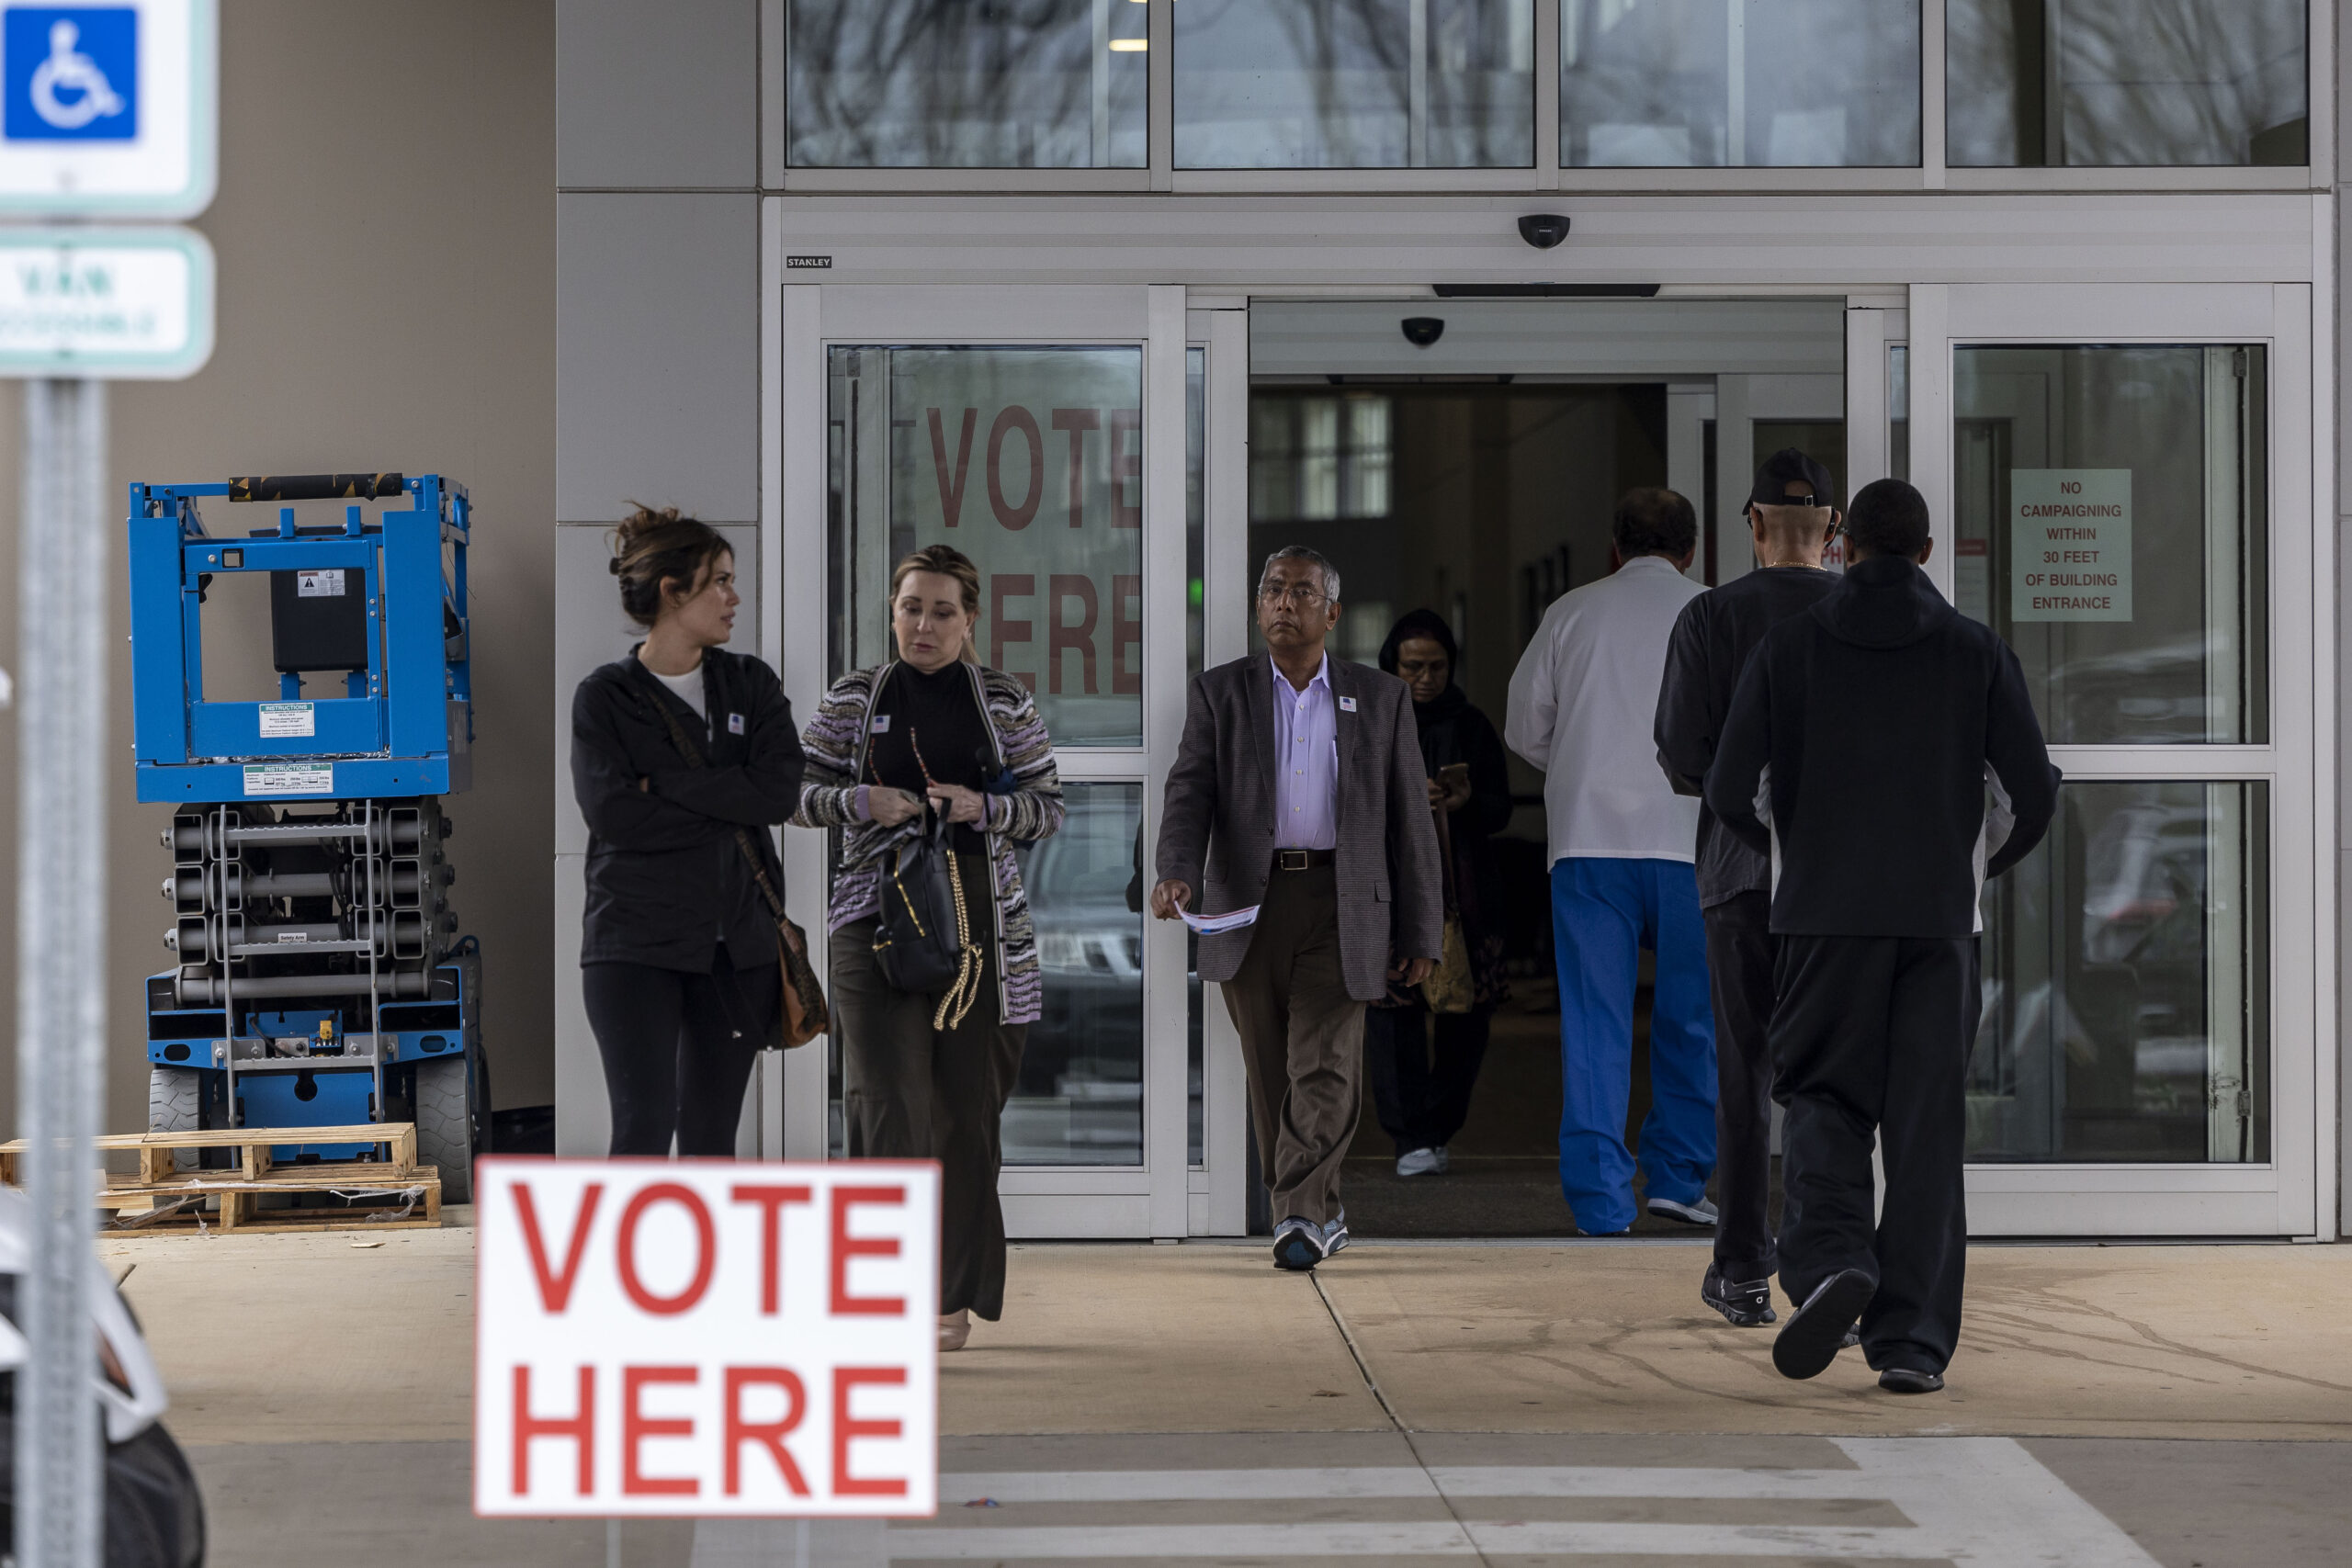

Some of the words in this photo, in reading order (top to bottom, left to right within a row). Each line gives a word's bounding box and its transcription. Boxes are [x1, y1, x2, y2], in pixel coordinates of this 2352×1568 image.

[787, 258, 831, 266] STANLEY
[926, 405, 1141, 531] VOTE
[2060, 481, 2082, 494] NO
[2020, 504, 2122, 517] CAMPAIGNING
[2046, 527, 2097, 540] WITHIN
[2042, 550, 2060, 563] 30
[2064, 550, 2100, 563] FEET
[2025, 573, 2045, 586] OF
[2050, 573, 2118, 586] BUILDING
[2032, 596, 2111, 609] ENTRANCE
[970, 574, 1141, 694] ERE
[508, 1180, 908, 1317] VOTE
[511, 1364, 909, 1497] HERE
